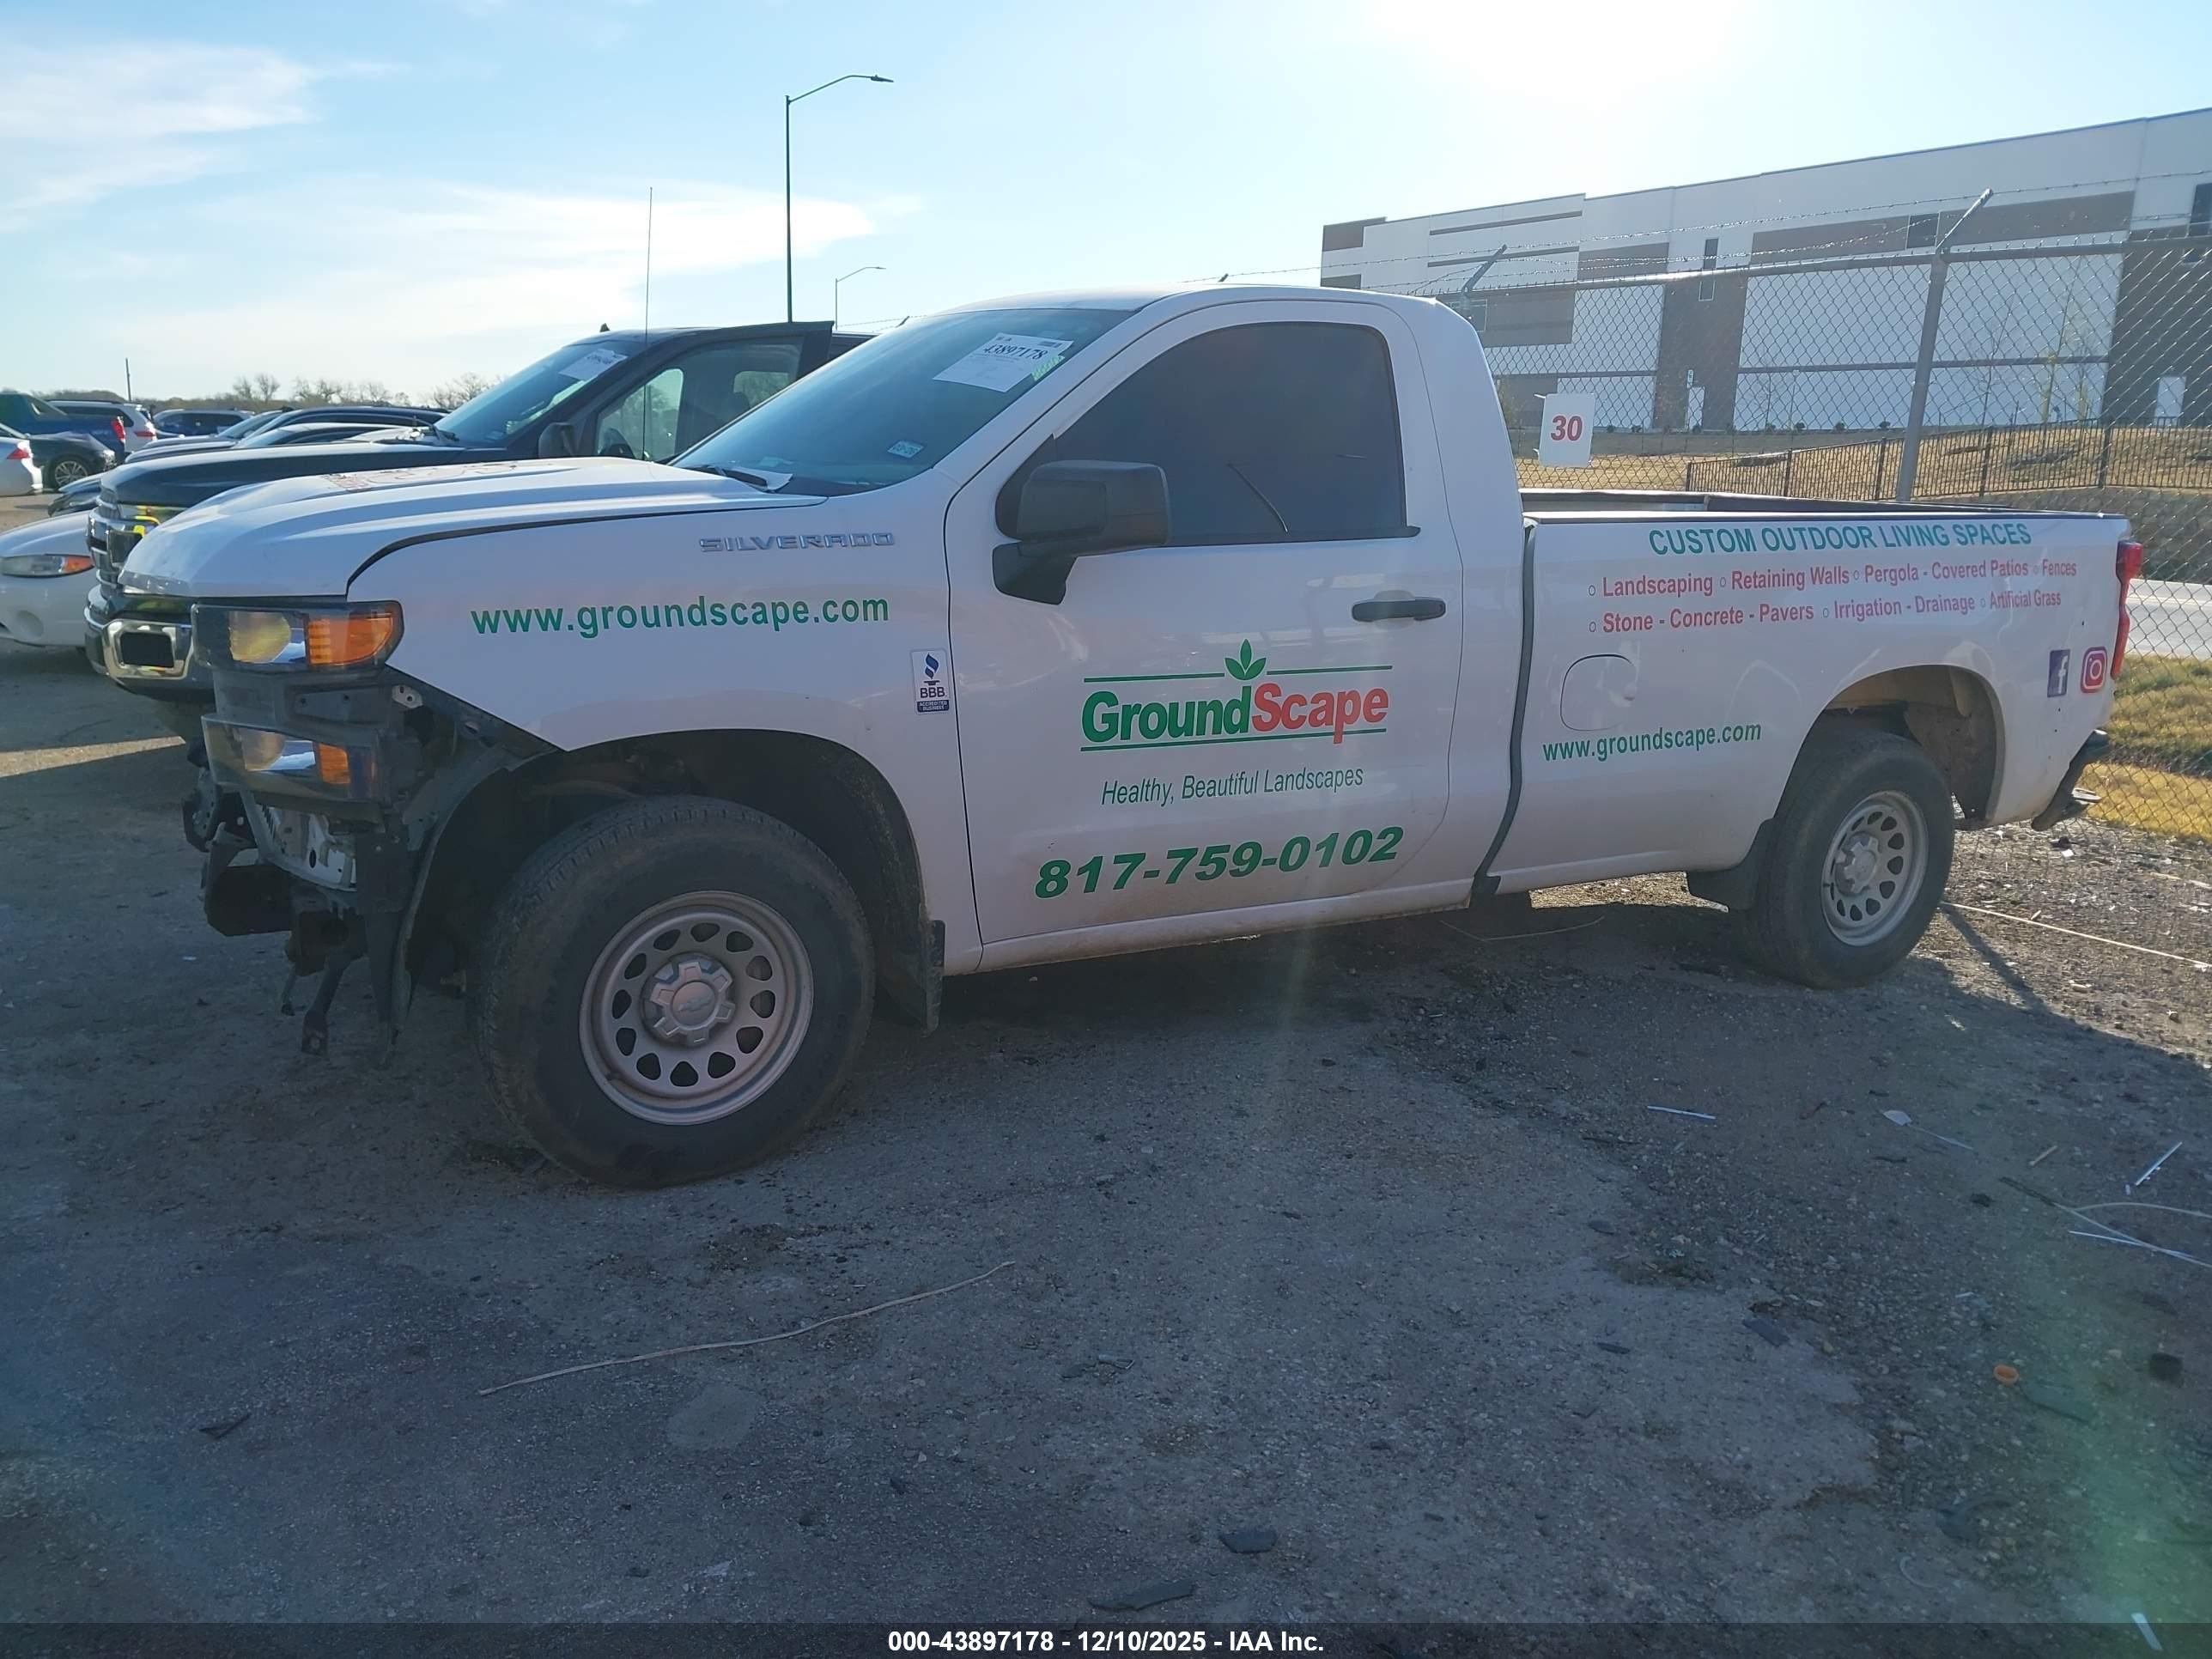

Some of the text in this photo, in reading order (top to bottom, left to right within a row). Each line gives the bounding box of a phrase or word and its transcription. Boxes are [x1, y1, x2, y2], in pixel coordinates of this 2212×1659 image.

[1551, 416, 1583, 441] 30
[699, 532, 895, 552] SILVERADO
[1649, 523, 2032, 556] CUSTOM OUTDOOR LIVING SPACES
[1602, 574, 1714, 598] Landscaping
[1731, 568, 1805, 590] Retaining
[1810, 565, 1850, 585] Walls
[1864, 563, 1919, 586] Pergola
[1931, 558, 1986, 579] Covered
[1990, 558, 2028, 576] Patios
[2042, 559, 2077, 577] Fences
[471, 596, 890, 638] www.groundscape.com
[1602, 612, 1653, 633] Stone
[1669, 606, 1744, 629] Concrete
[1759, 602, 1814, 623] Pavers
[1834, 598, 1902, 623] Irrigation
[1915, 594, 1975, 616] Drainage
[1990, 590, 2033, 610] Artificial
[2034, 590, 2061, 606] Grass
[920, 686, 945, 698] BBB
[1082, 683, 1389, 744] GroundScape
[1542, 723, 1761, 762] www.groundscape.com
[1101, 767, 1364, 806] Healthy, Beautiful Landscapes
[1035, 826, 1405, 899] 817-759-0102
